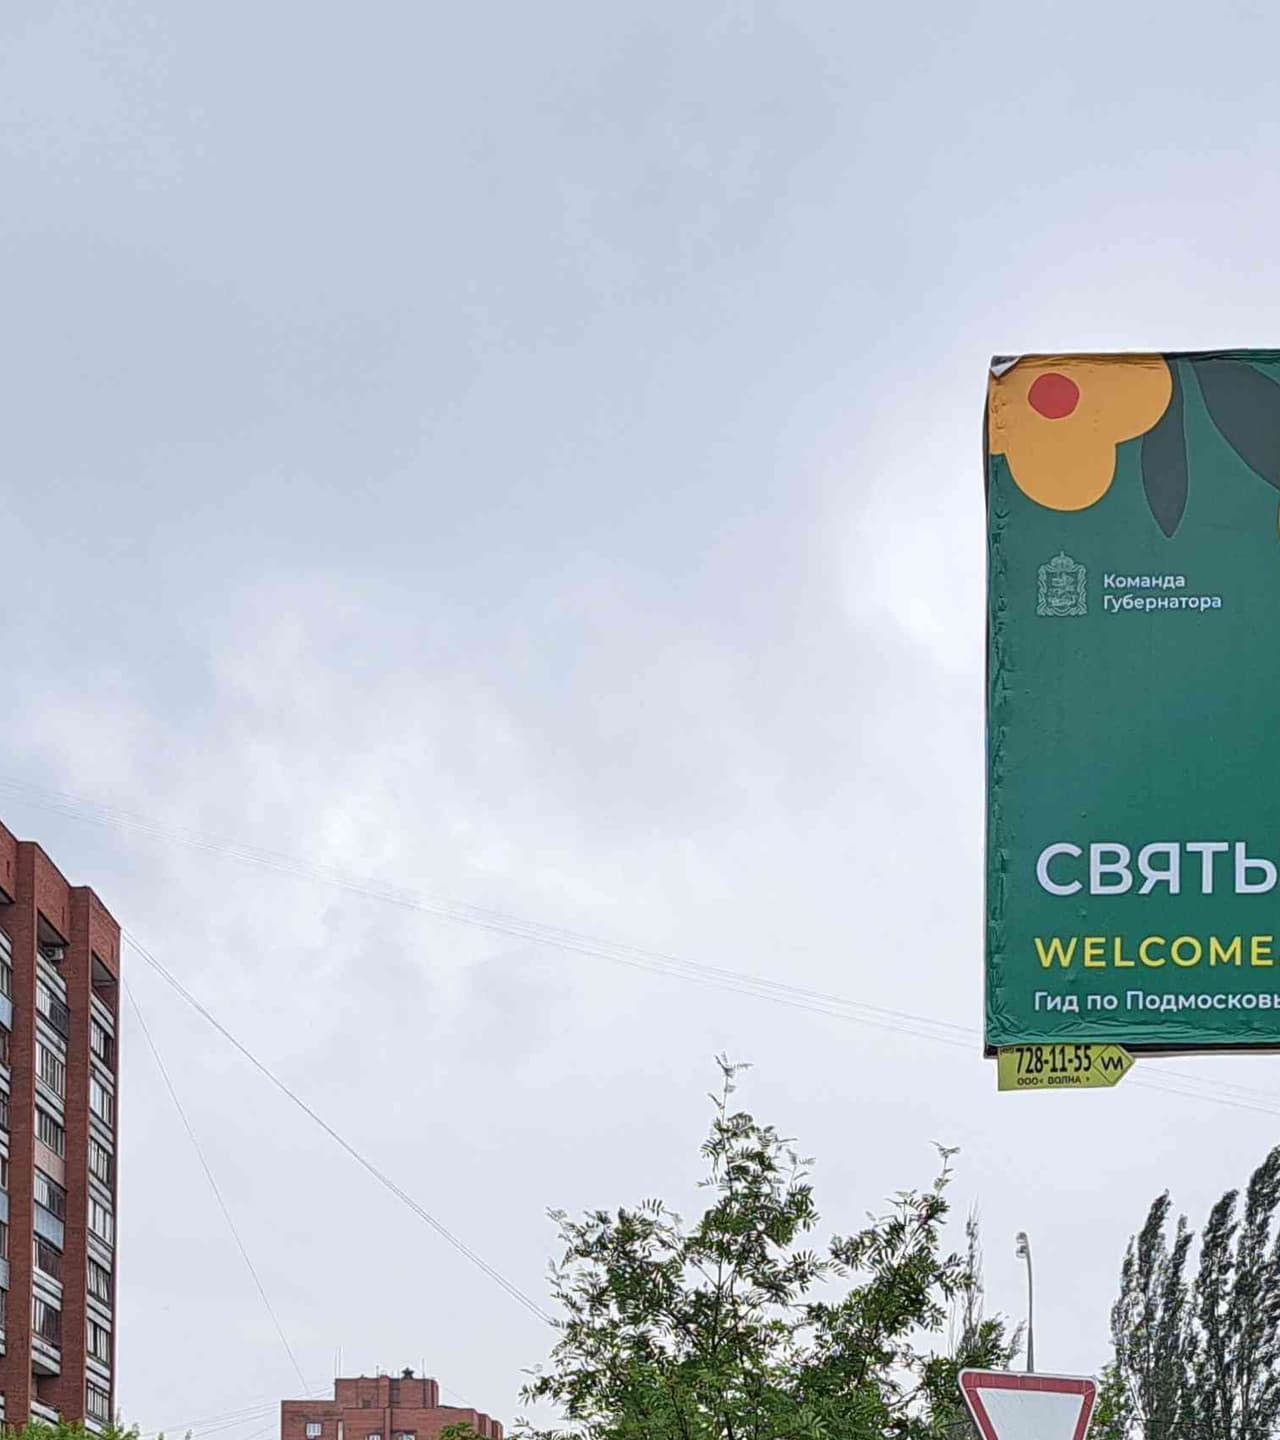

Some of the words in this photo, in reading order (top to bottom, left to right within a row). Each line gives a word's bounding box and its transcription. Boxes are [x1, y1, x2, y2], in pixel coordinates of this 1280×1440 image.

[1102, 571, 1186, 592] Команда
[1102, 592, 1223, 614] Губернатора
[1033, 990, 1078, 1014] Гид
[1086, 993, 1118, 1011] по
[1015, 1045, 1092, 1074] 728-11-55
